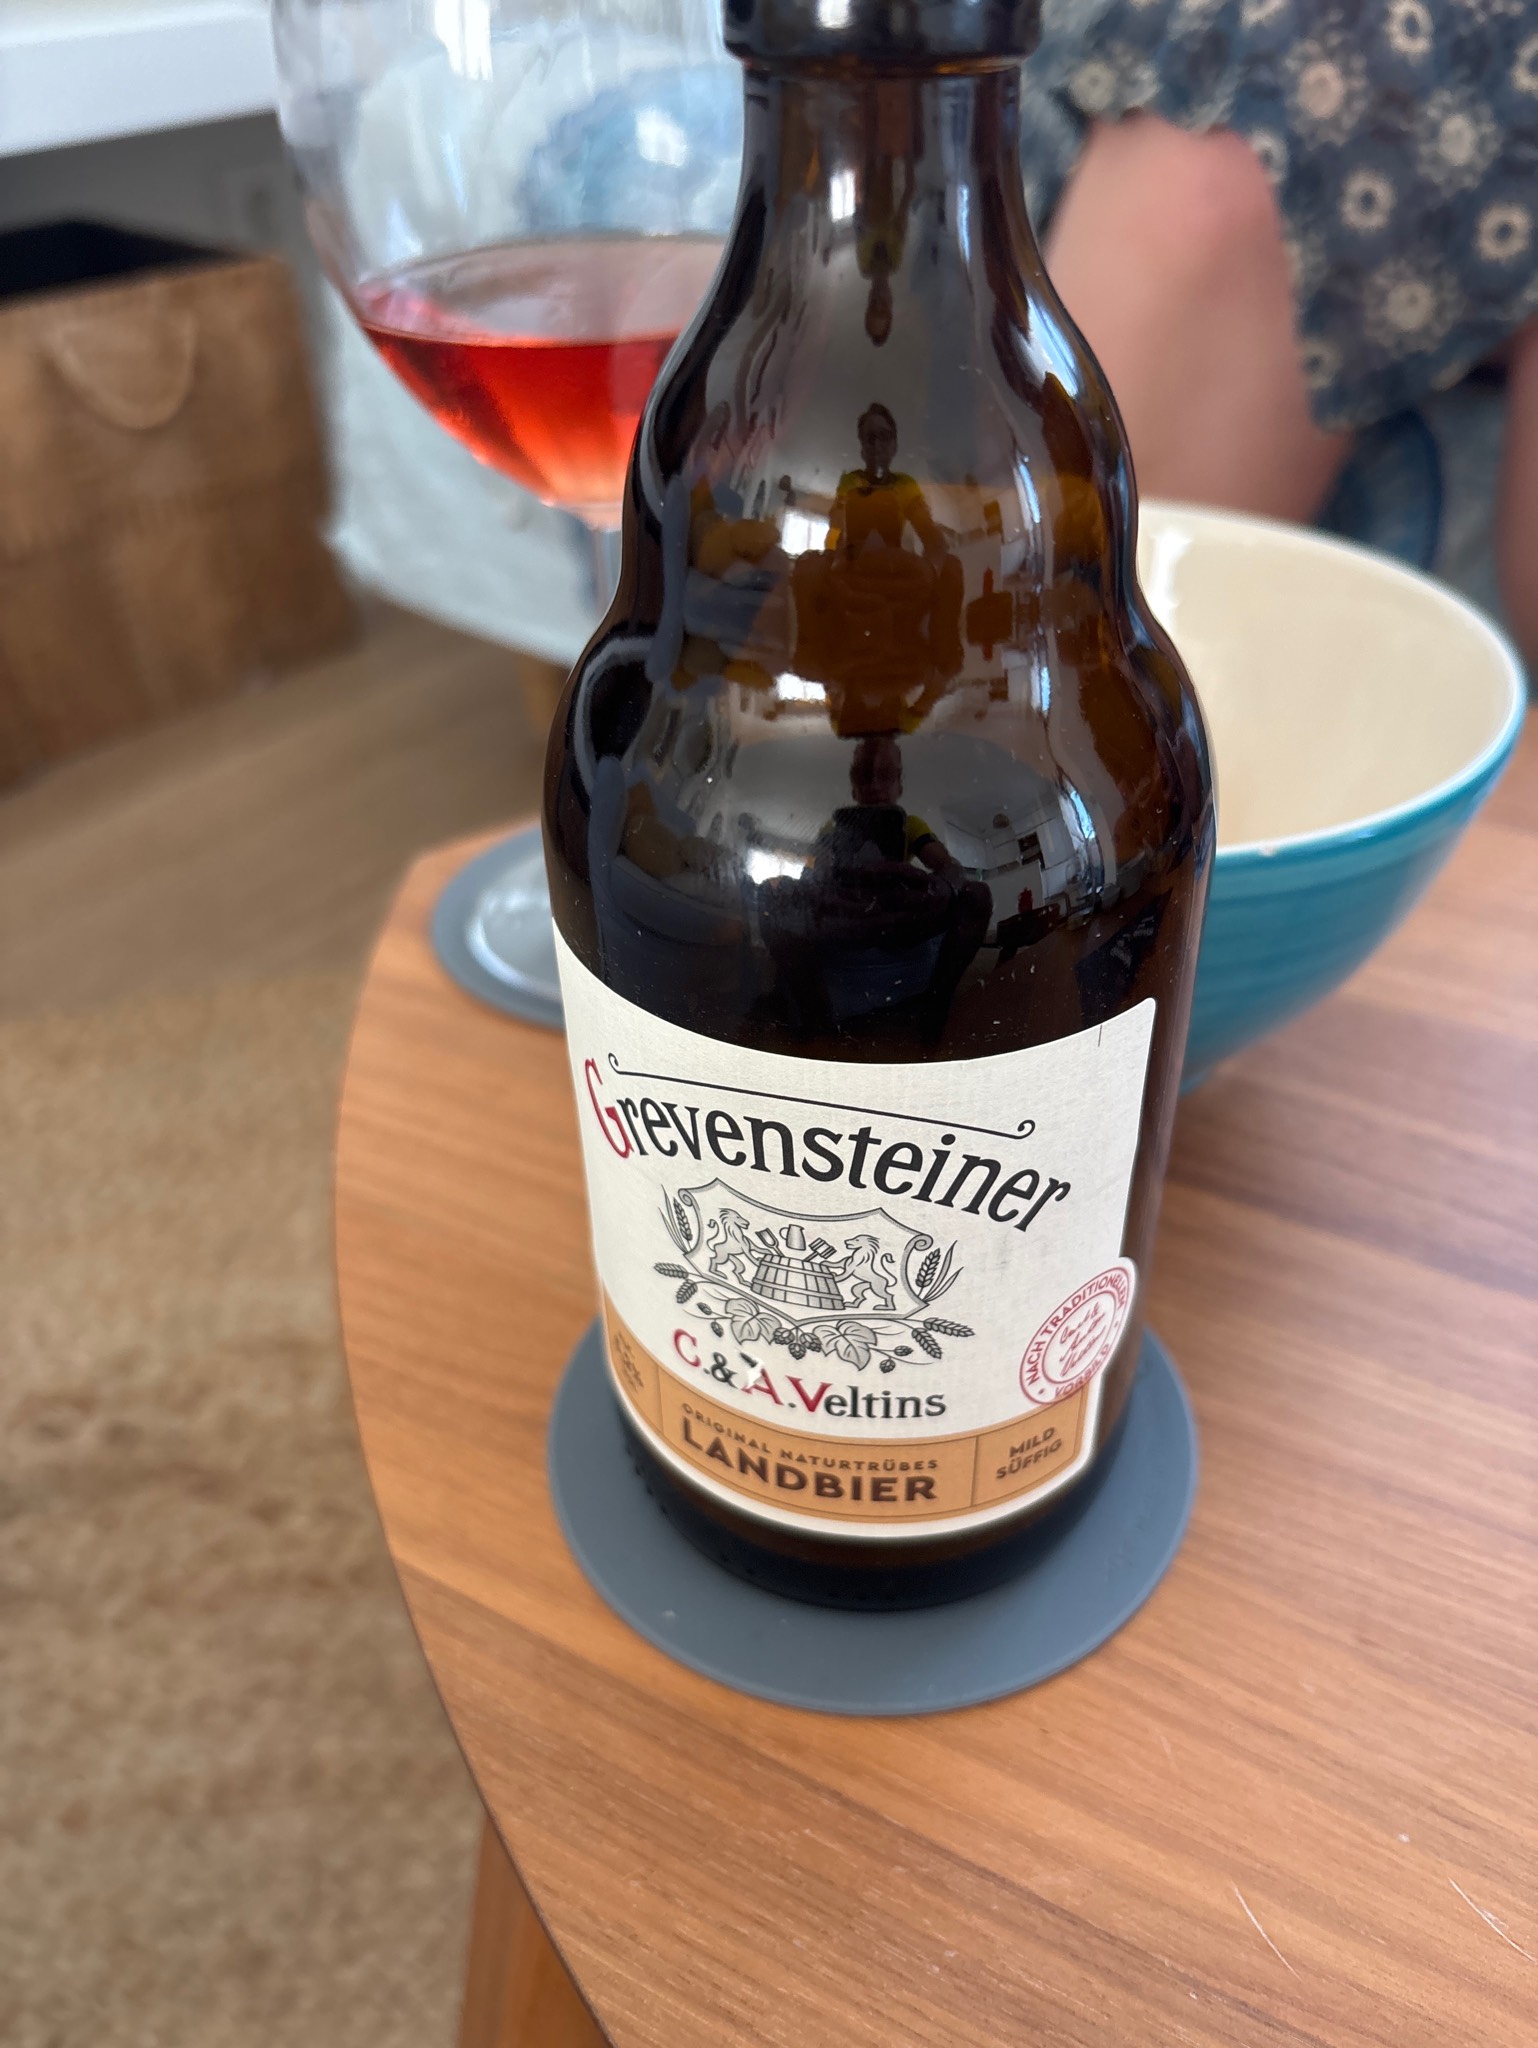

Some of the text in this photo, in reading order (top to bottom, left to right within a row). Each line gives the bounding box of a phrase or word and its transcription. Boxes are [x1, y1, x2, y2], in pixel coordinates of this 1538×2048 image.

[585, 1057, 1071, 1232] Grevensteiner
[1026, 1340, 1046, 1386] NACH
[681, 1402, 938, 1472] ORIGINAL NATURTRÜBES
[683, 1416, 938, 1501] LANDBIER
[996, 1438, 1062, 1479] SÜFFIG
[1009, 1427, 1055, 1457] MILD
